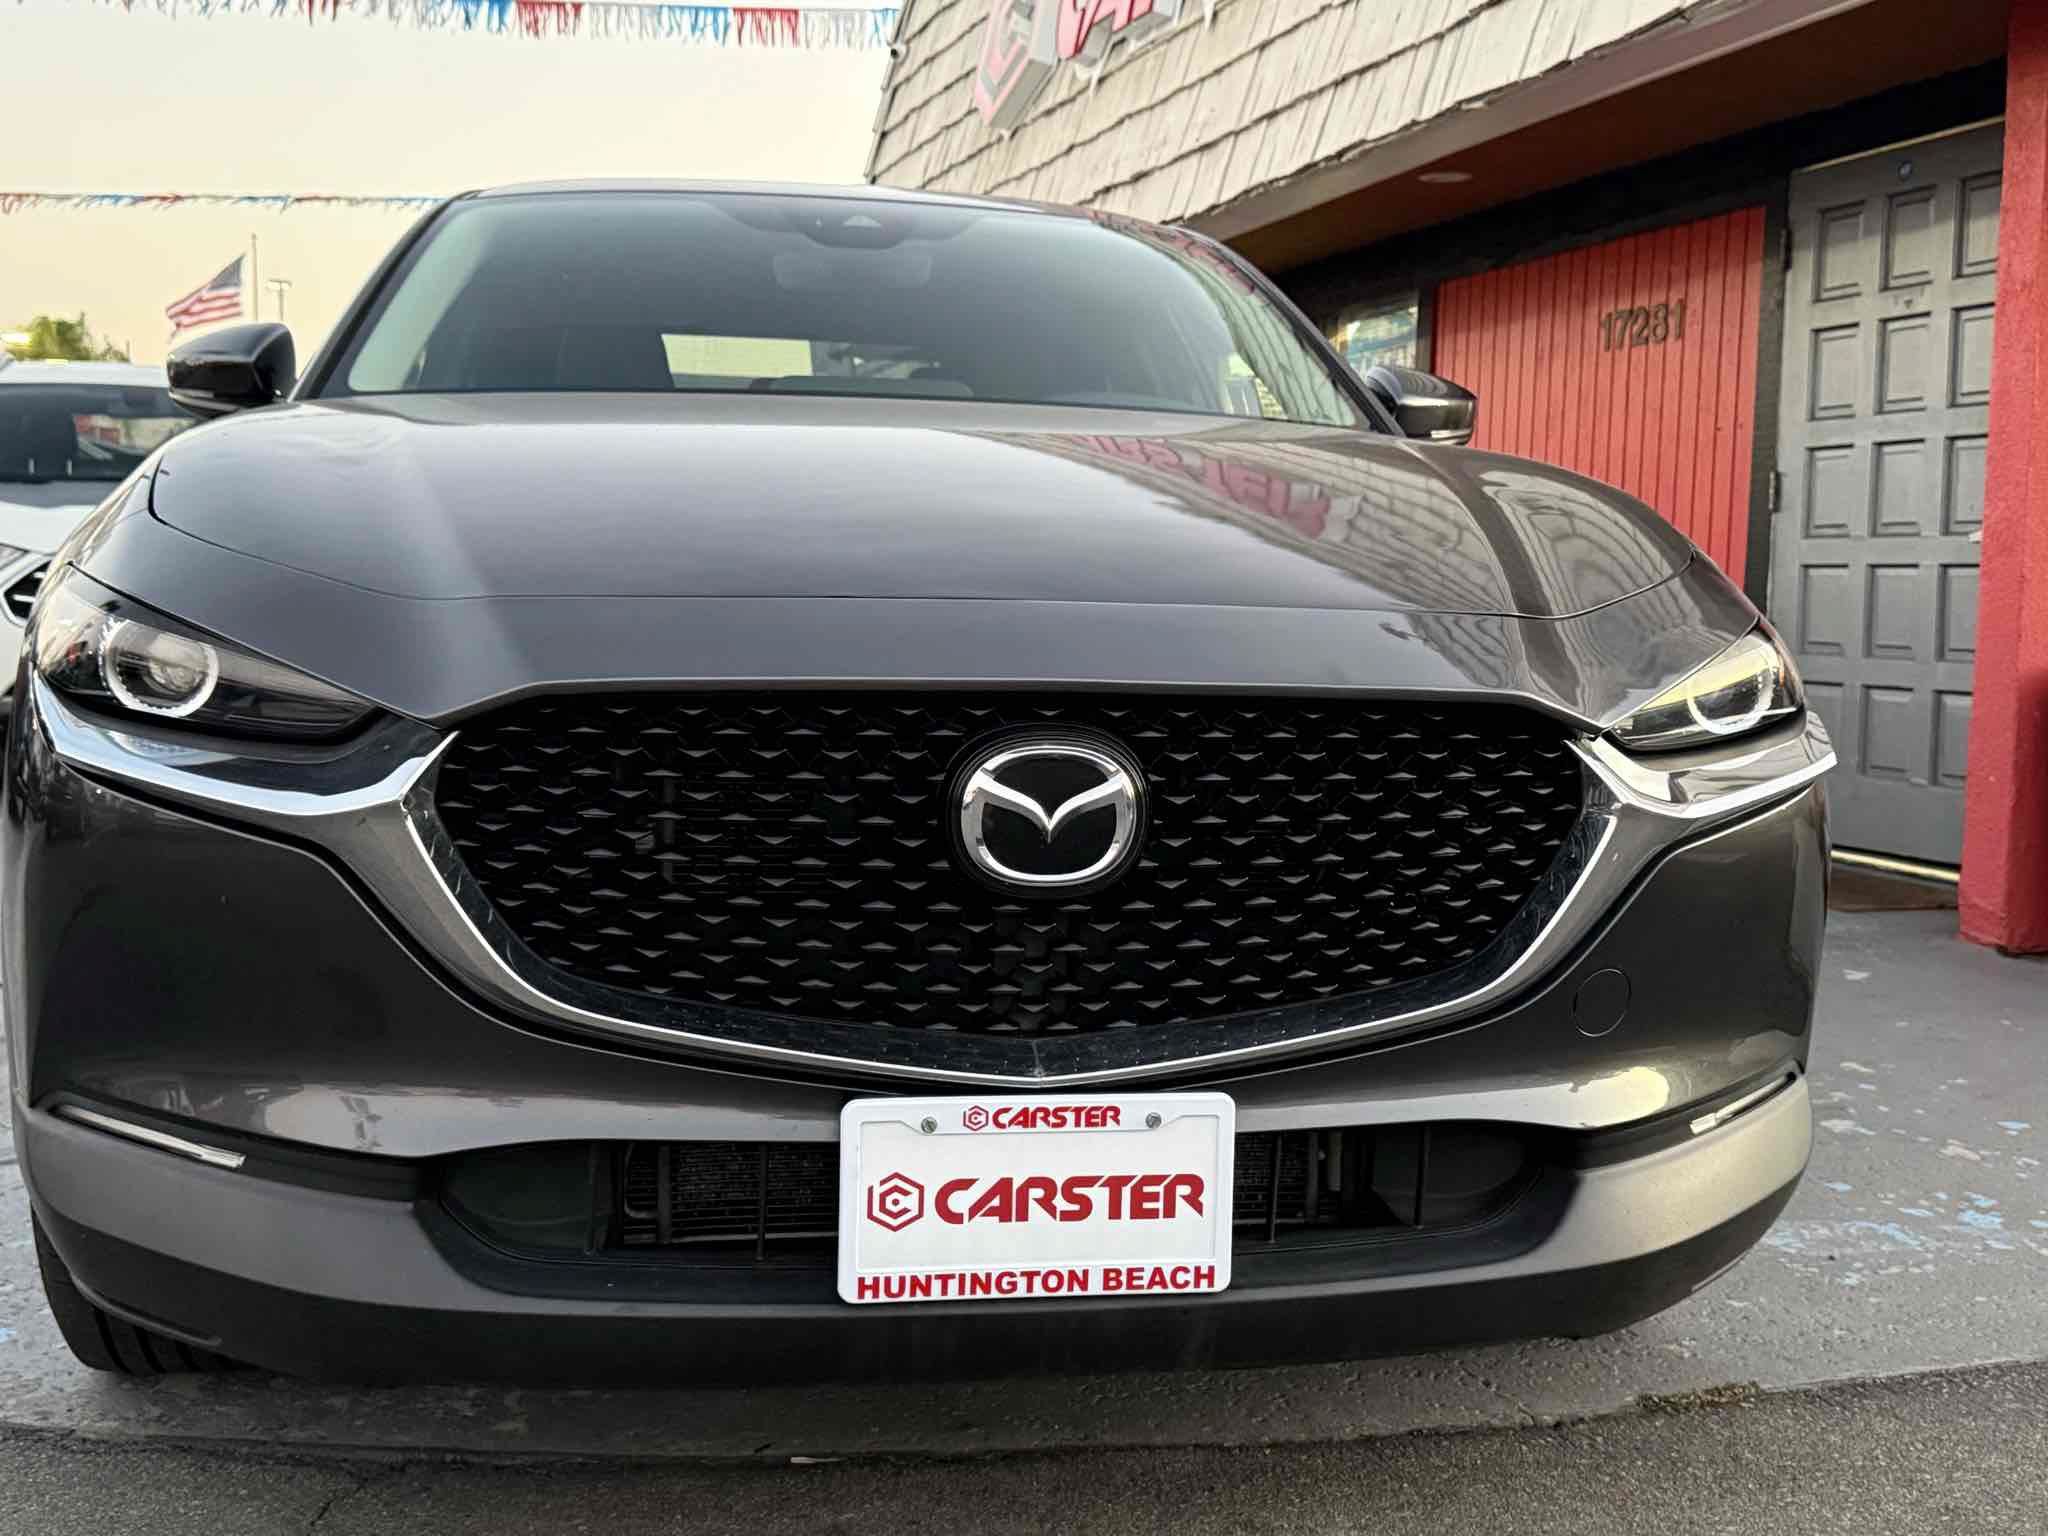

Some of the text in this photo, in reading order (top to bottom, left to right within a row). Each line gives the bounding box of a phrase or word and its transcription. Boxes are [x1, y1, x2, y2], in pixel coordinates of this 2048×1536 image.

[1601, 300, 1685, 351] 17281
[992, 1105, 1121, 1129] CARSTER
[934, 1173, 1205, 1225] CARSTER
[857, 1265, 1215, 1299] HUNTINGTON BEACH
